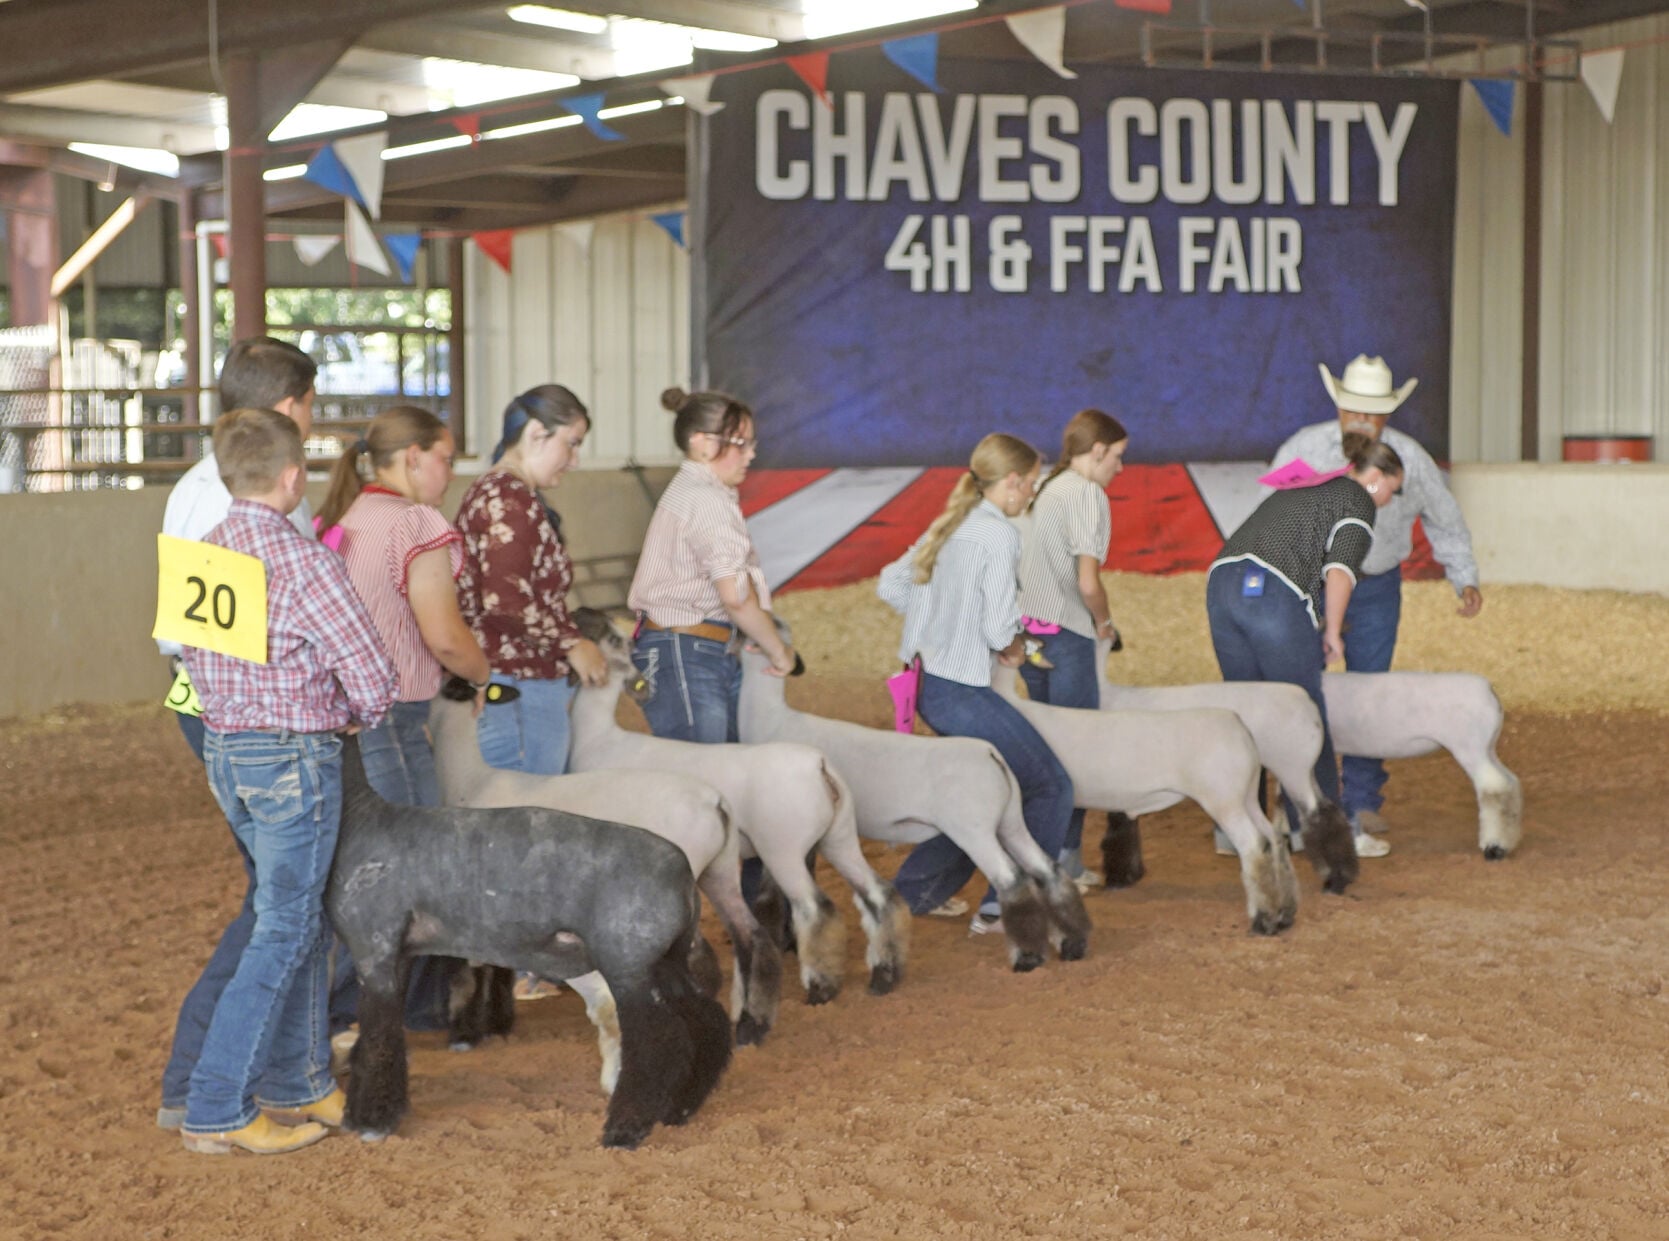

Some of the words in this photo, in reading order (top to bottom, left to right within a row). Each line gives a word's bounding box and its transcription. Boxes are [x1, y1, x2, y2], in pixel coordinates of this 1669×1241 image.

[756, 89, 1081, 202] CHAVES
[1107, 97, 1418, 206] COUNTY
[884, 214, 971, 293] 4H
[988, 215, 1032, 293] &
[1050, 215, 1162, 294] FFA
[1179, 216, 1302, 294] FAIR
[184, 575, 236, 630] 20
